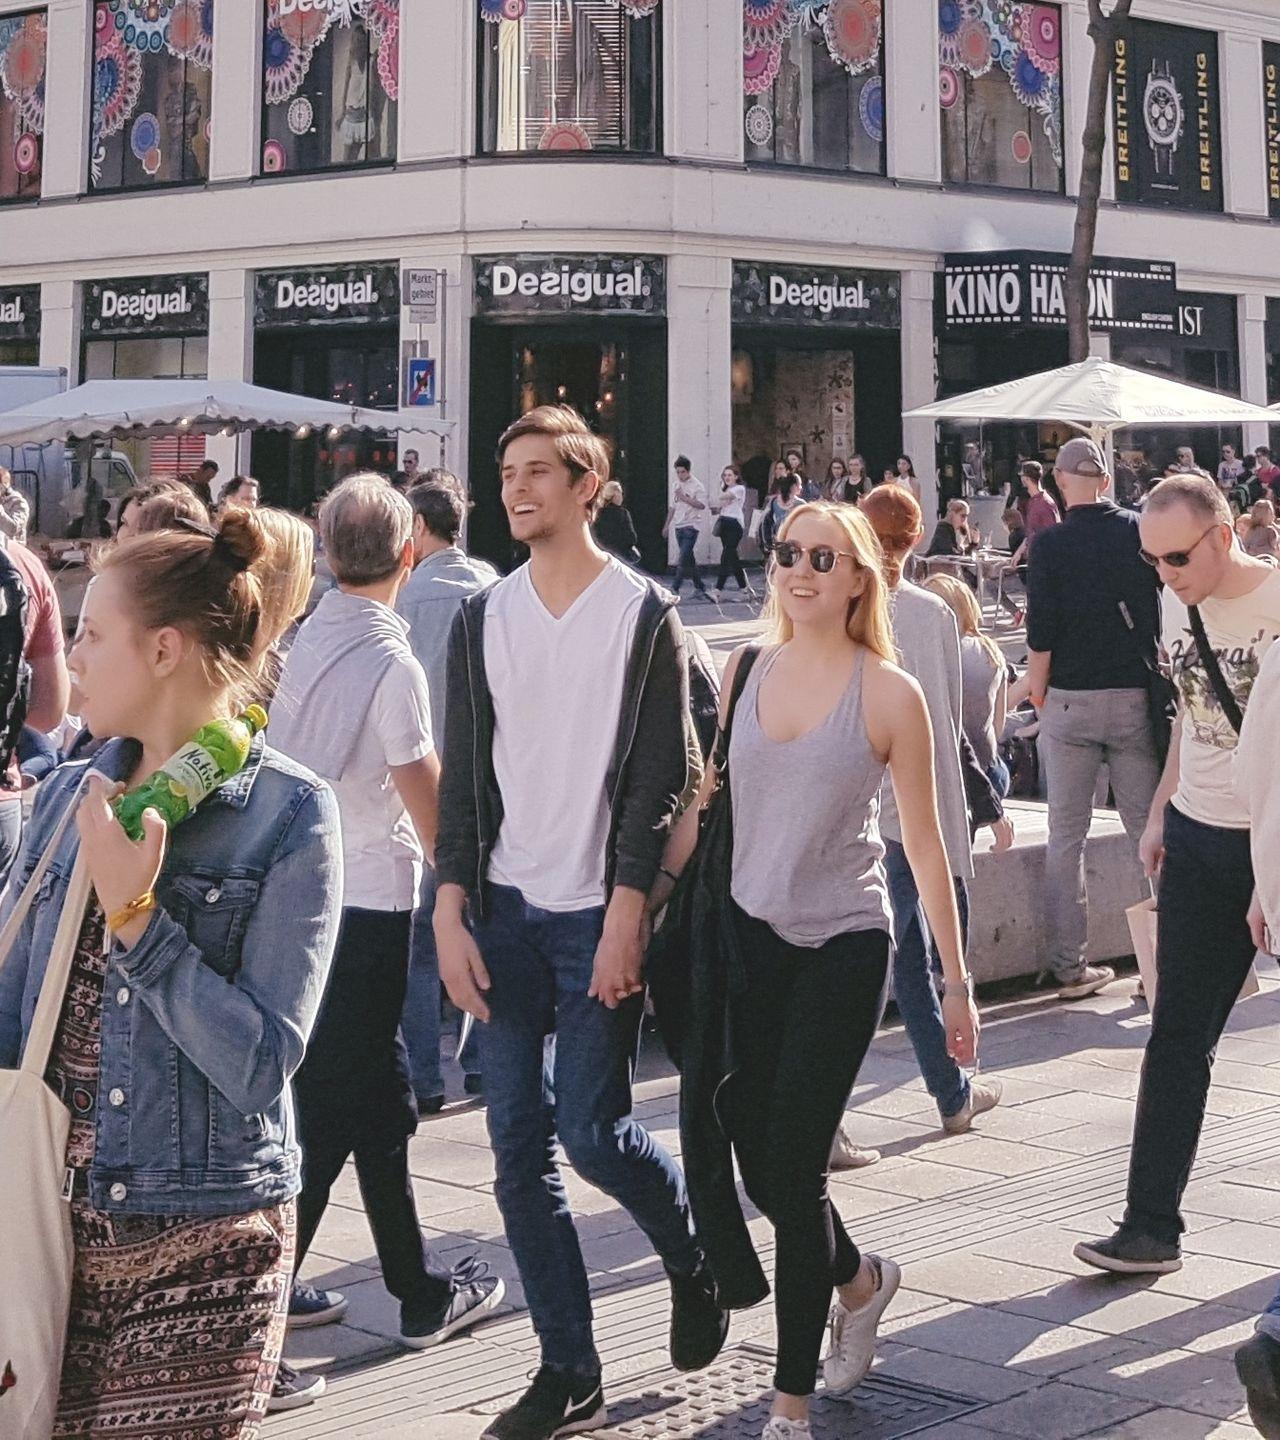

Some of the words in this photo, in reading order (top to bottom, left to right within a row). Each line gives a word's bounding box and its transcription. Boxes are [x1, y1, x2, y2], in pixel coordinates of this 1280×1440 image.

[1115, 38, 1129, 182] BREITLING
[1197, 53, 1211, 191] BREITLING
[1266, 64, 1280, 199] BREITLING
[946, 272, 1020, 316] KINO
